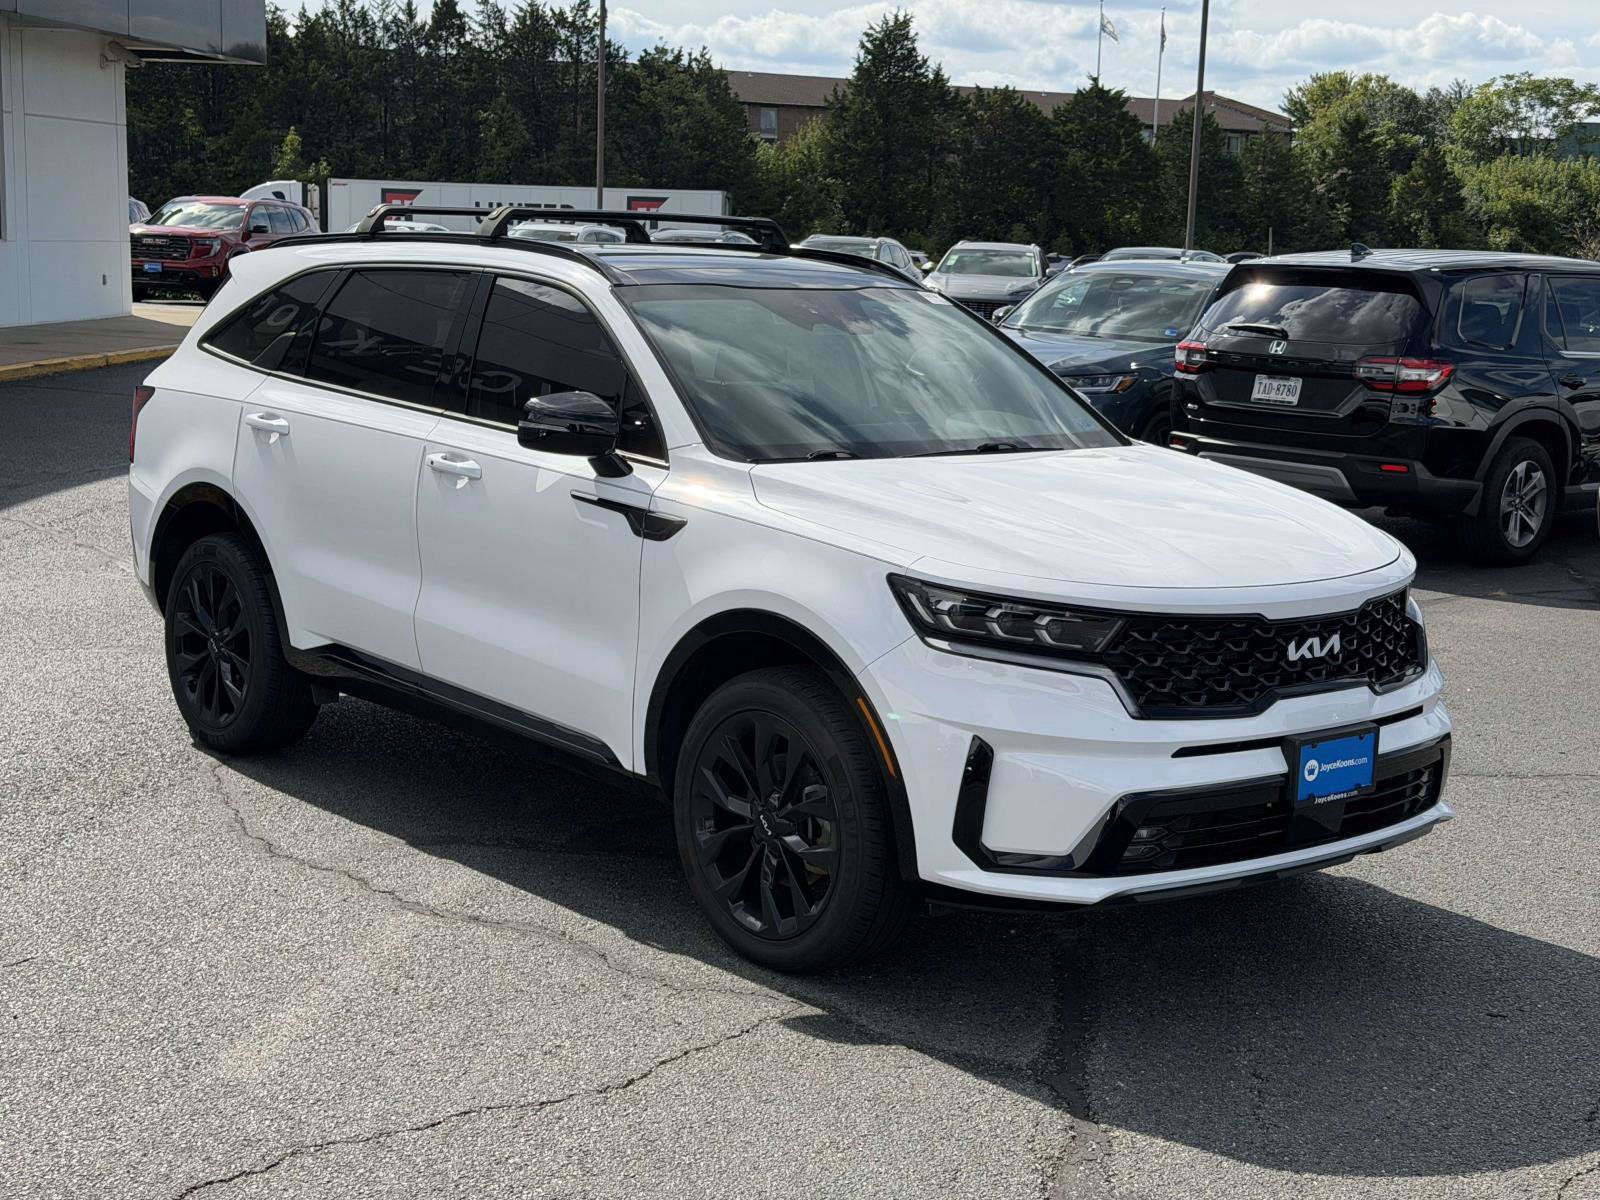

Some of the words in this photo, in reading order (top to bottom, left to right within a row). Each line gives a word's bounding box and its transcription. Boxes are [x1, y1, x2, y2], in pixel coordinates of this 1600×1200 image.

[1257, 381, 1298, 397] TAD-8780
[1287, 633, 1340, 661] KIA
[1320, 757, 1368, 772] JoyceKoons.com
